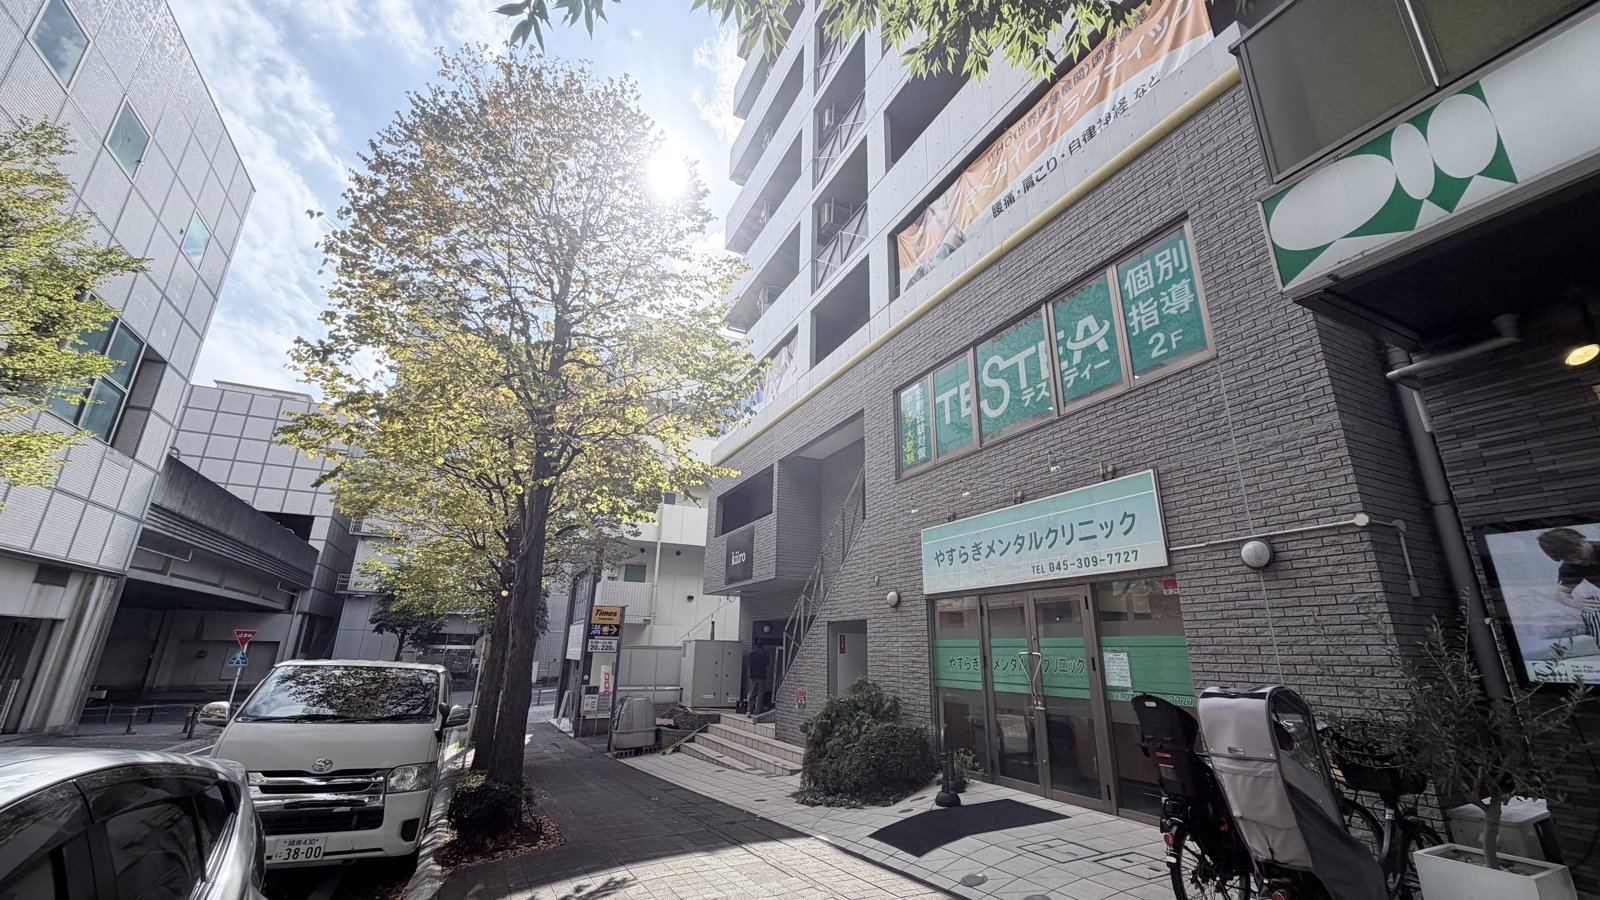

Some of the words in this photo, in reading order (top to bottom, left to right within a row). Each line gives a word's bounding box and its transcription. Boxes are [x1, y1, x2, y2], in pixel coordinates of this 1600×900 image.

[991, 96, 1128, 219] 腰痛・肩こり・自律神経
[1134, 71, 1161, 100] など
[1124, 239, 1189, 300] 個別
[1128, 278, 1195, 337] 指導
[1147, 329, 1184, 360] 2F
[935, 314, 1110, 426] TESTEA
[1021, 359, 1110, 407] テスティー
[934, 511, 1137, 568] やすらぎメンタルクリニック
[1031, 565, 1046, 575] TEL
[1049, 549, 1139, 573] 045-309-7727
[595, 608, 618, 617] Times
[949, 655, 979, 671] やすらぎ
[1042, 657, 1085, 674] クリニック
[283, 846, 322, 861] 38-00
[302, 838, 316, 846] 430
